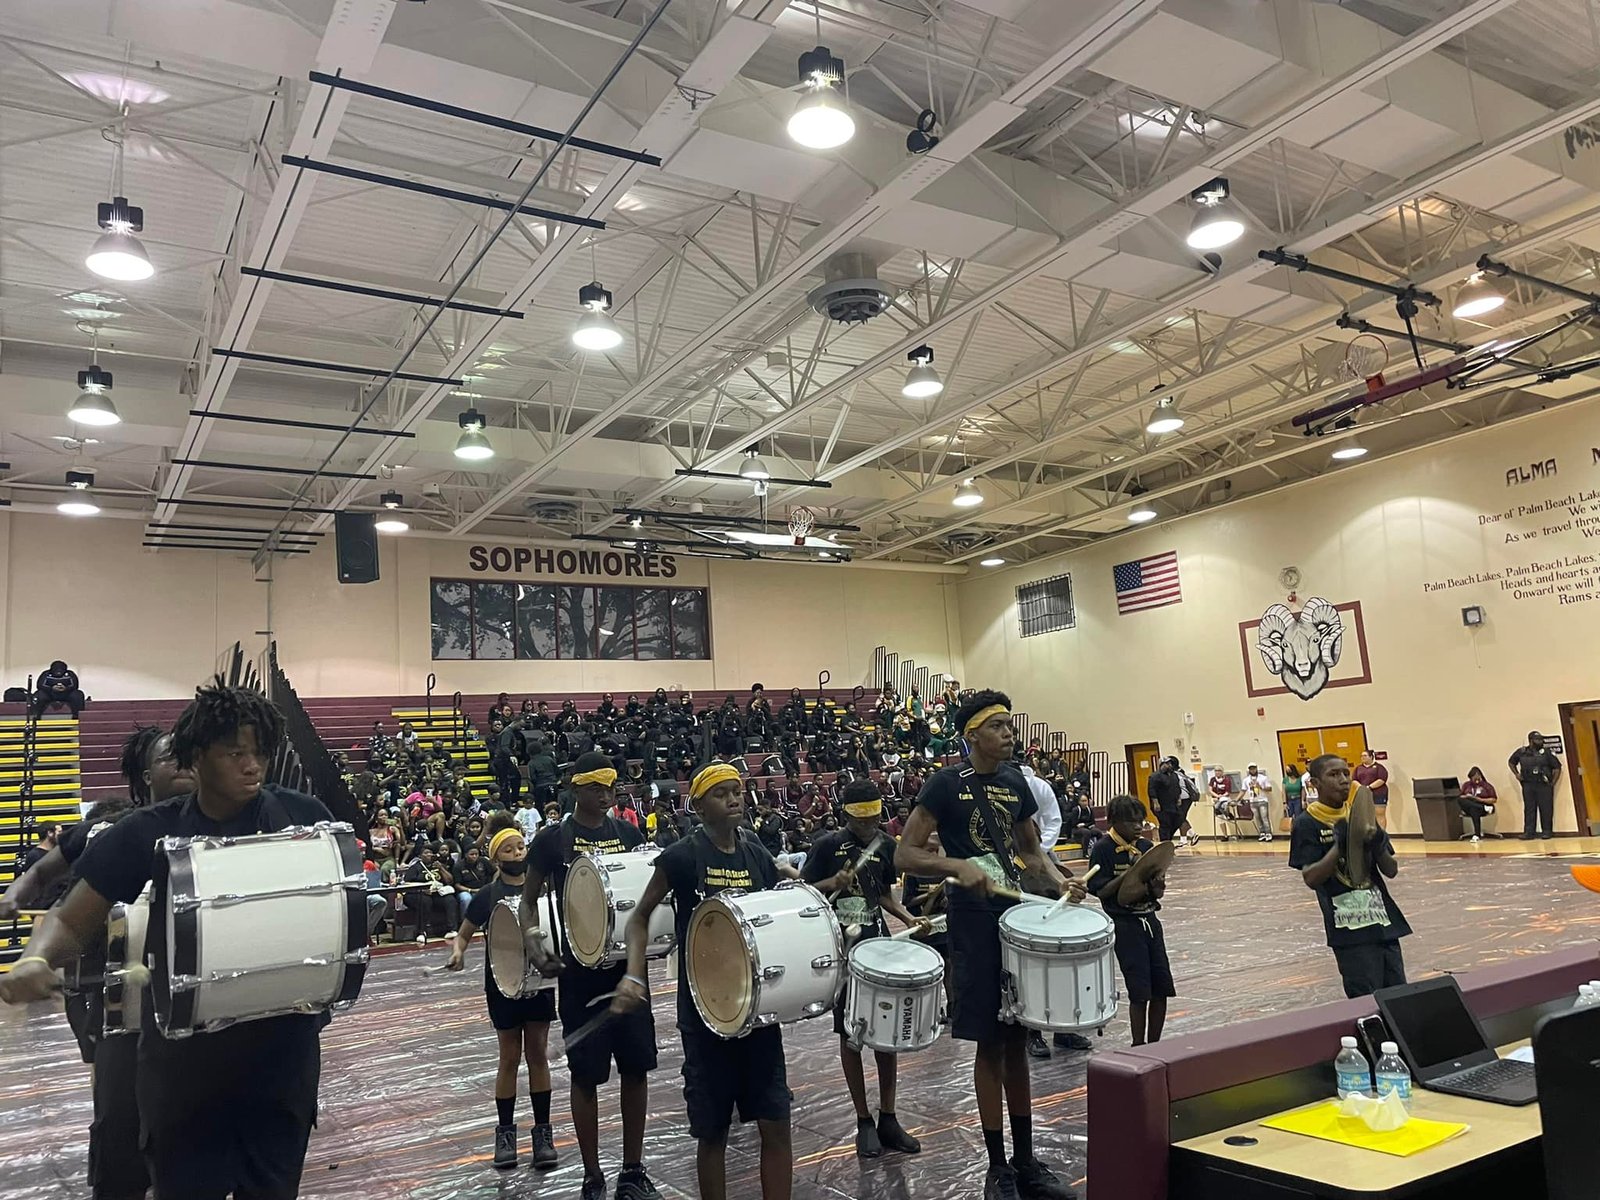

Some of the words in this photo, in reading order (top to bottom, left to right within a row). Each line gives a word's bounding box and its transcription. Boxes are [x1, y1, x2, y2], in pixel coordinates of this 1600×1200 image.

[1506, 458, 1557, 487] ALMA
[1478, 514, 1502, 525] Dear
[1504, 508, 1514, 520] of
[1518, 504, 1543, 517] Palm
[1544, 495, 1576, 511] Beach
[1568, 504, 1586, 517] We
[1505, 533, 1520, 544] As
[1523, 531, 1537, 540] we
[1543, 520, 1572, 536] travel
[469, 545, 678, 578] SOPHOMORES
[1423, 581, 1447, 593] Palm
[1447, 575, 1476, 588] Beach
[1506, 566, 1531, 577] Palm
[1531, 559, 1563, 573] Beach
[1500, 576, 1533, 591] Heads
[1536, 571, 1555, 584] and
[1556, 567, 1590, 581] hearts
[1513, 583, 1554, 600] Onward
[1557, 583, 1572, 593] we
[1575, 576, 1595, 590] will
[1558, 592, 1593, 605] Rams
[902, 1006, 913, 1042] YAMAHA
